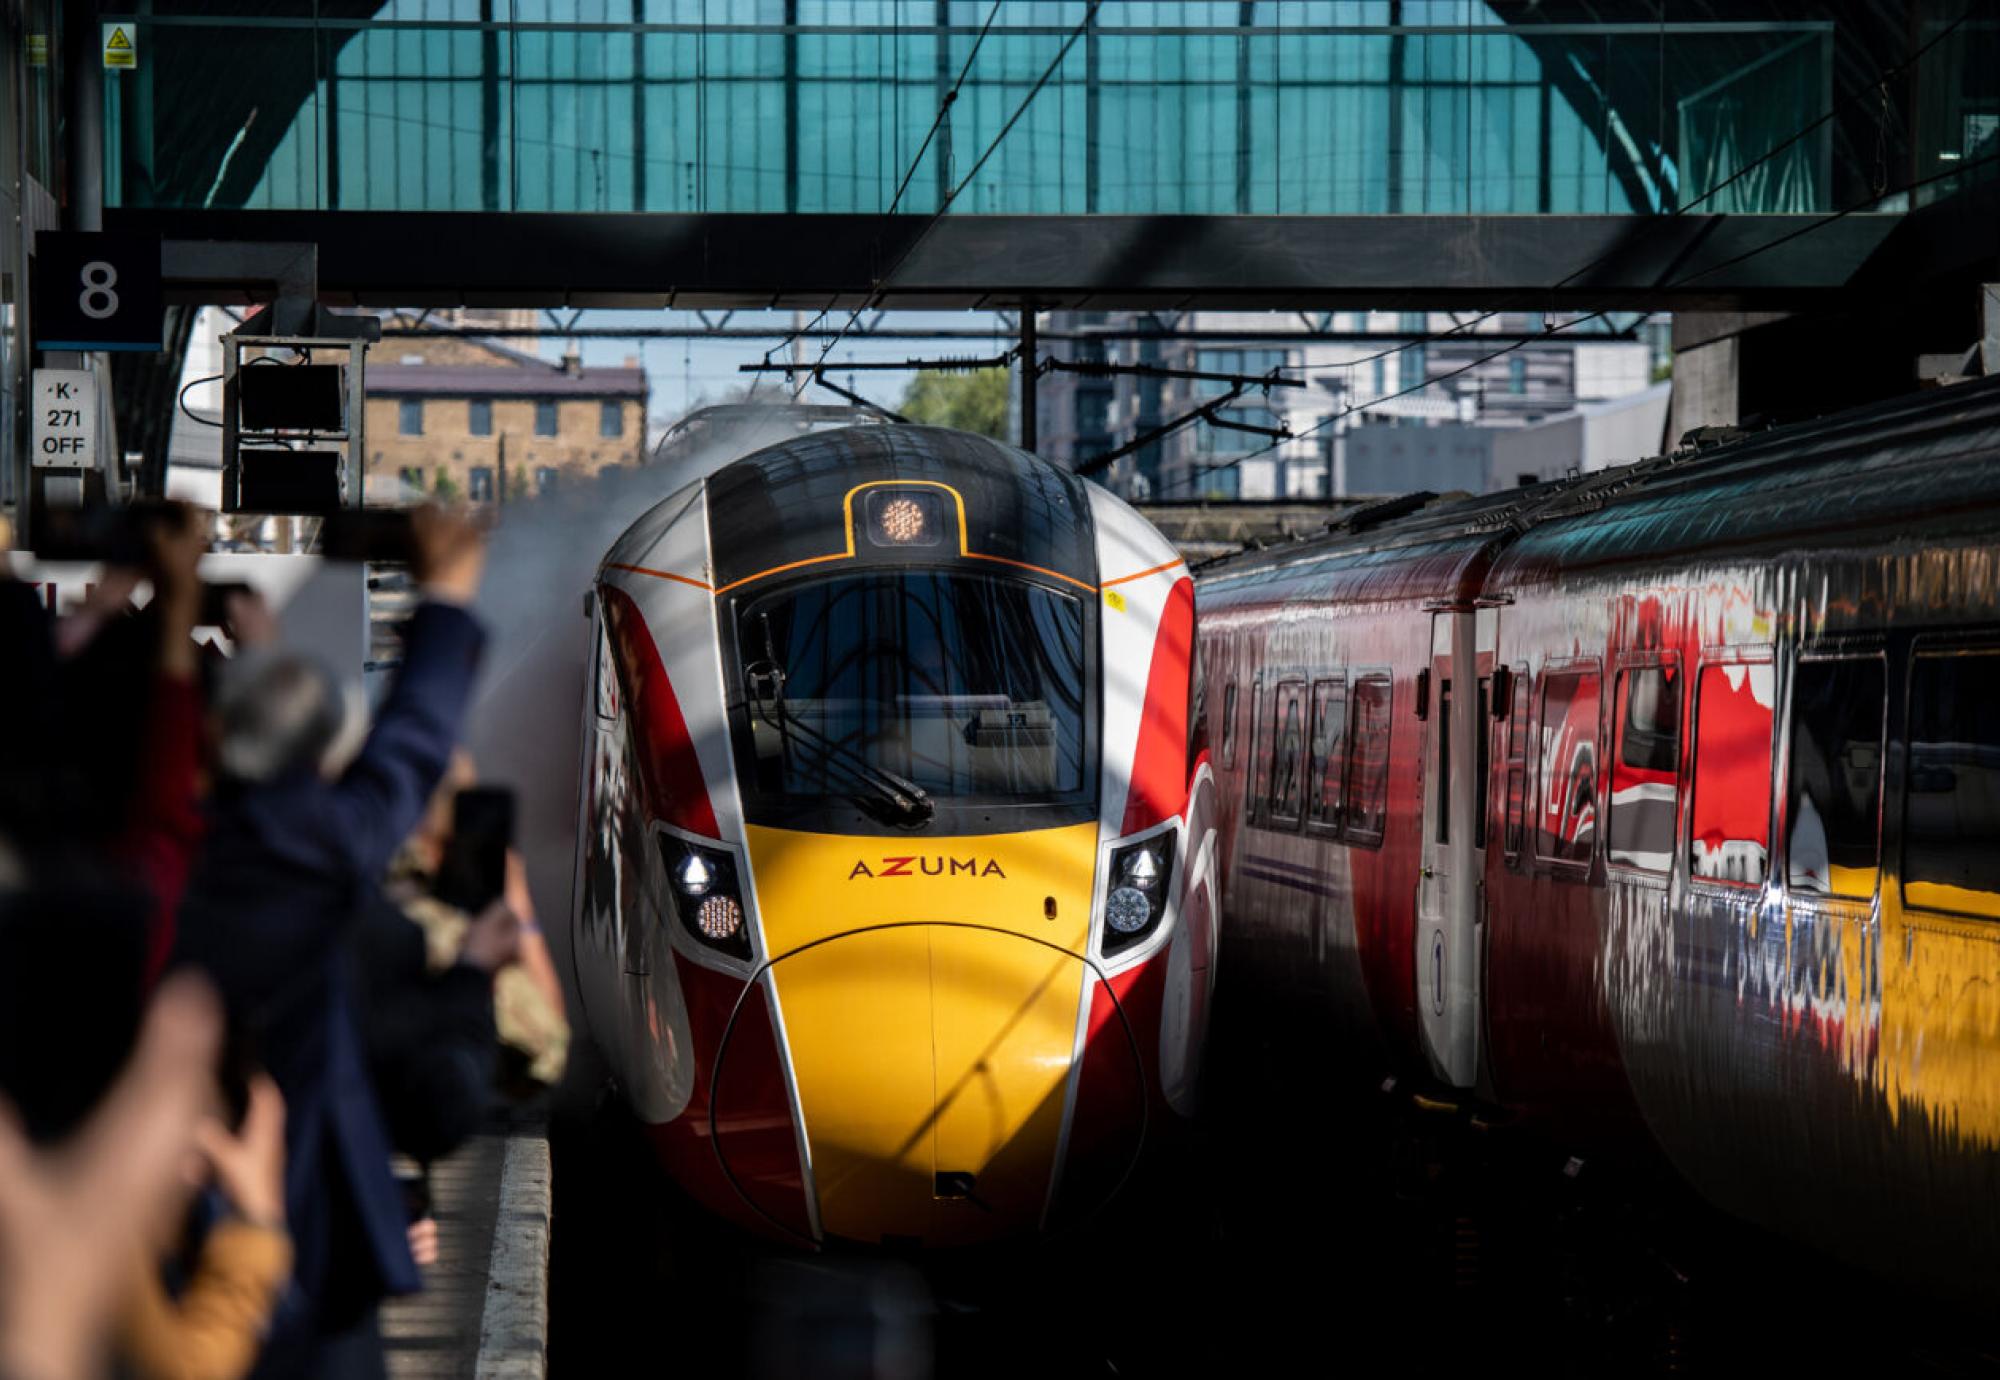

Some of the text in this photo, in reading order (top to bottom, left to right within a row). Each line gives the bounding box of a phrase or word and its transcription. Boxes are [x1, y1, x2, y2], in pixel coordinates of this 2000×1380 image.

[79, 261, 119, 319] 8
[56, 382, 70, 400] K
[47, 410, 81, 427] 271
[42, 437, 85, 454] OFF
[848, 856, 1006, 880] AZUMA
